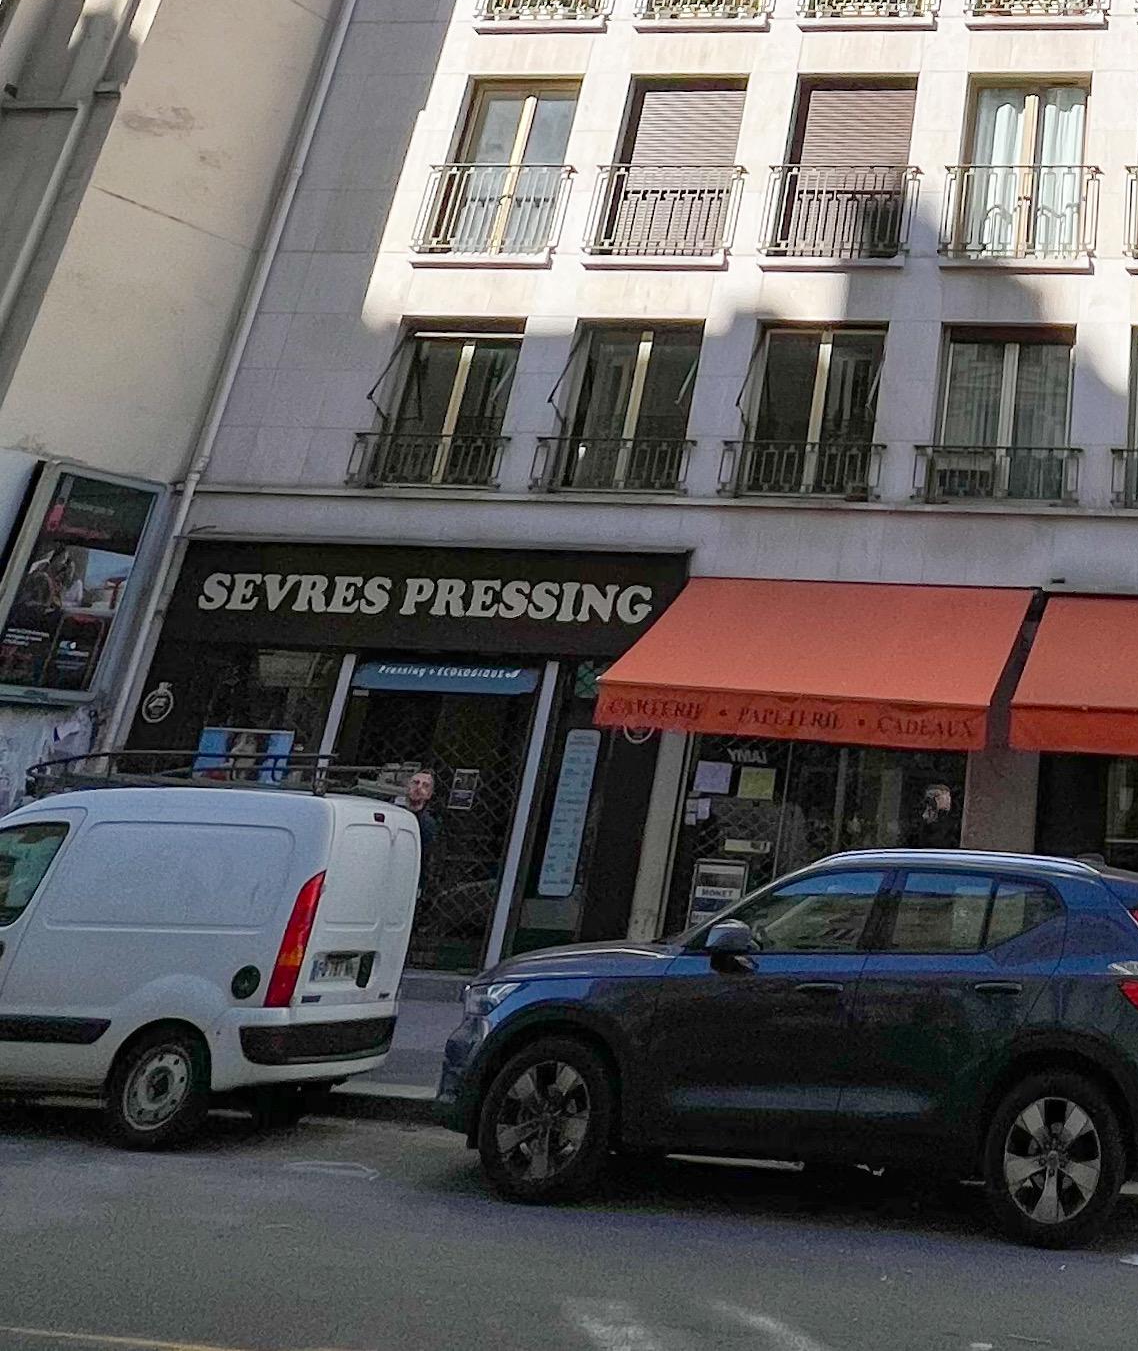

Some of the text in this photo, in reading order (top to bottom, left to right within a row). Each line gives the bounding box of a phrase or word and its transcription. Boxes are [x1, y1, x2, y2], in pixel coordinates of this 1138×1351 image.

[198, 572, 653, 625] SEVRES PRESSING
[738, 706, 844, 731] PAPETERIE
[877, 714, 975, 738] CADEAUX
